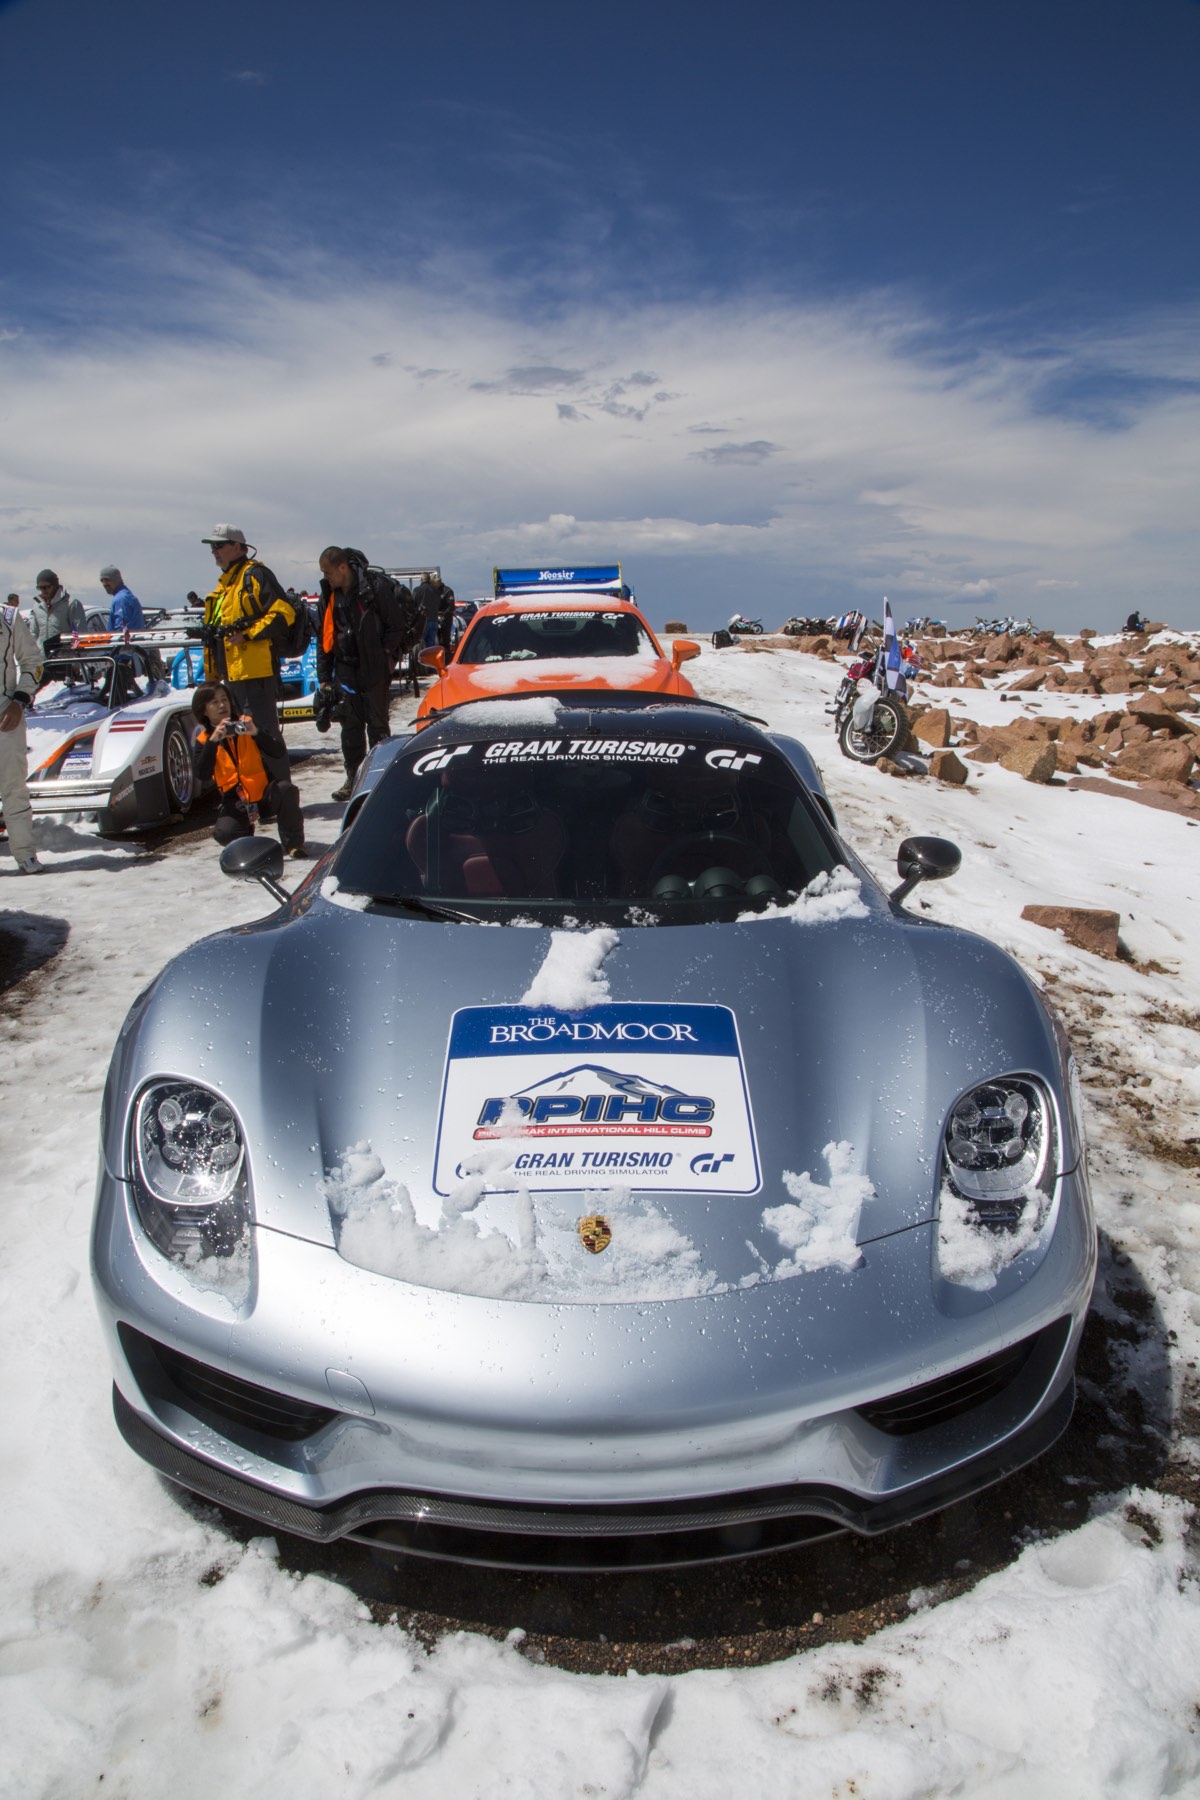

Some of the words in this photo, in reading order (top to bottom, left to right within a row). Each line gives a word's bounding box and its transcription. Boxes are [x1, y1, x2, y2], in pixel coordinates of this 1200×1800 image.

[538, 570, 575, 581] Hoosier
[485, 740, 562, 758] GRAN
[603, 755, 679, 765] SIMULATOR
[528, 1017, 556, 1025] THE
[489, 1023, 699, 1043] BROADMOOR
[476, 1095, 715, 1126] PPIHC
[547, 1126, 642, 1135] INTERNATIONAL
[670, 1127, 706, 1135] CLIMB
[515, 1152, 575, 1169] GRAN
[581, 1151, 674, 1168] TURISMO
